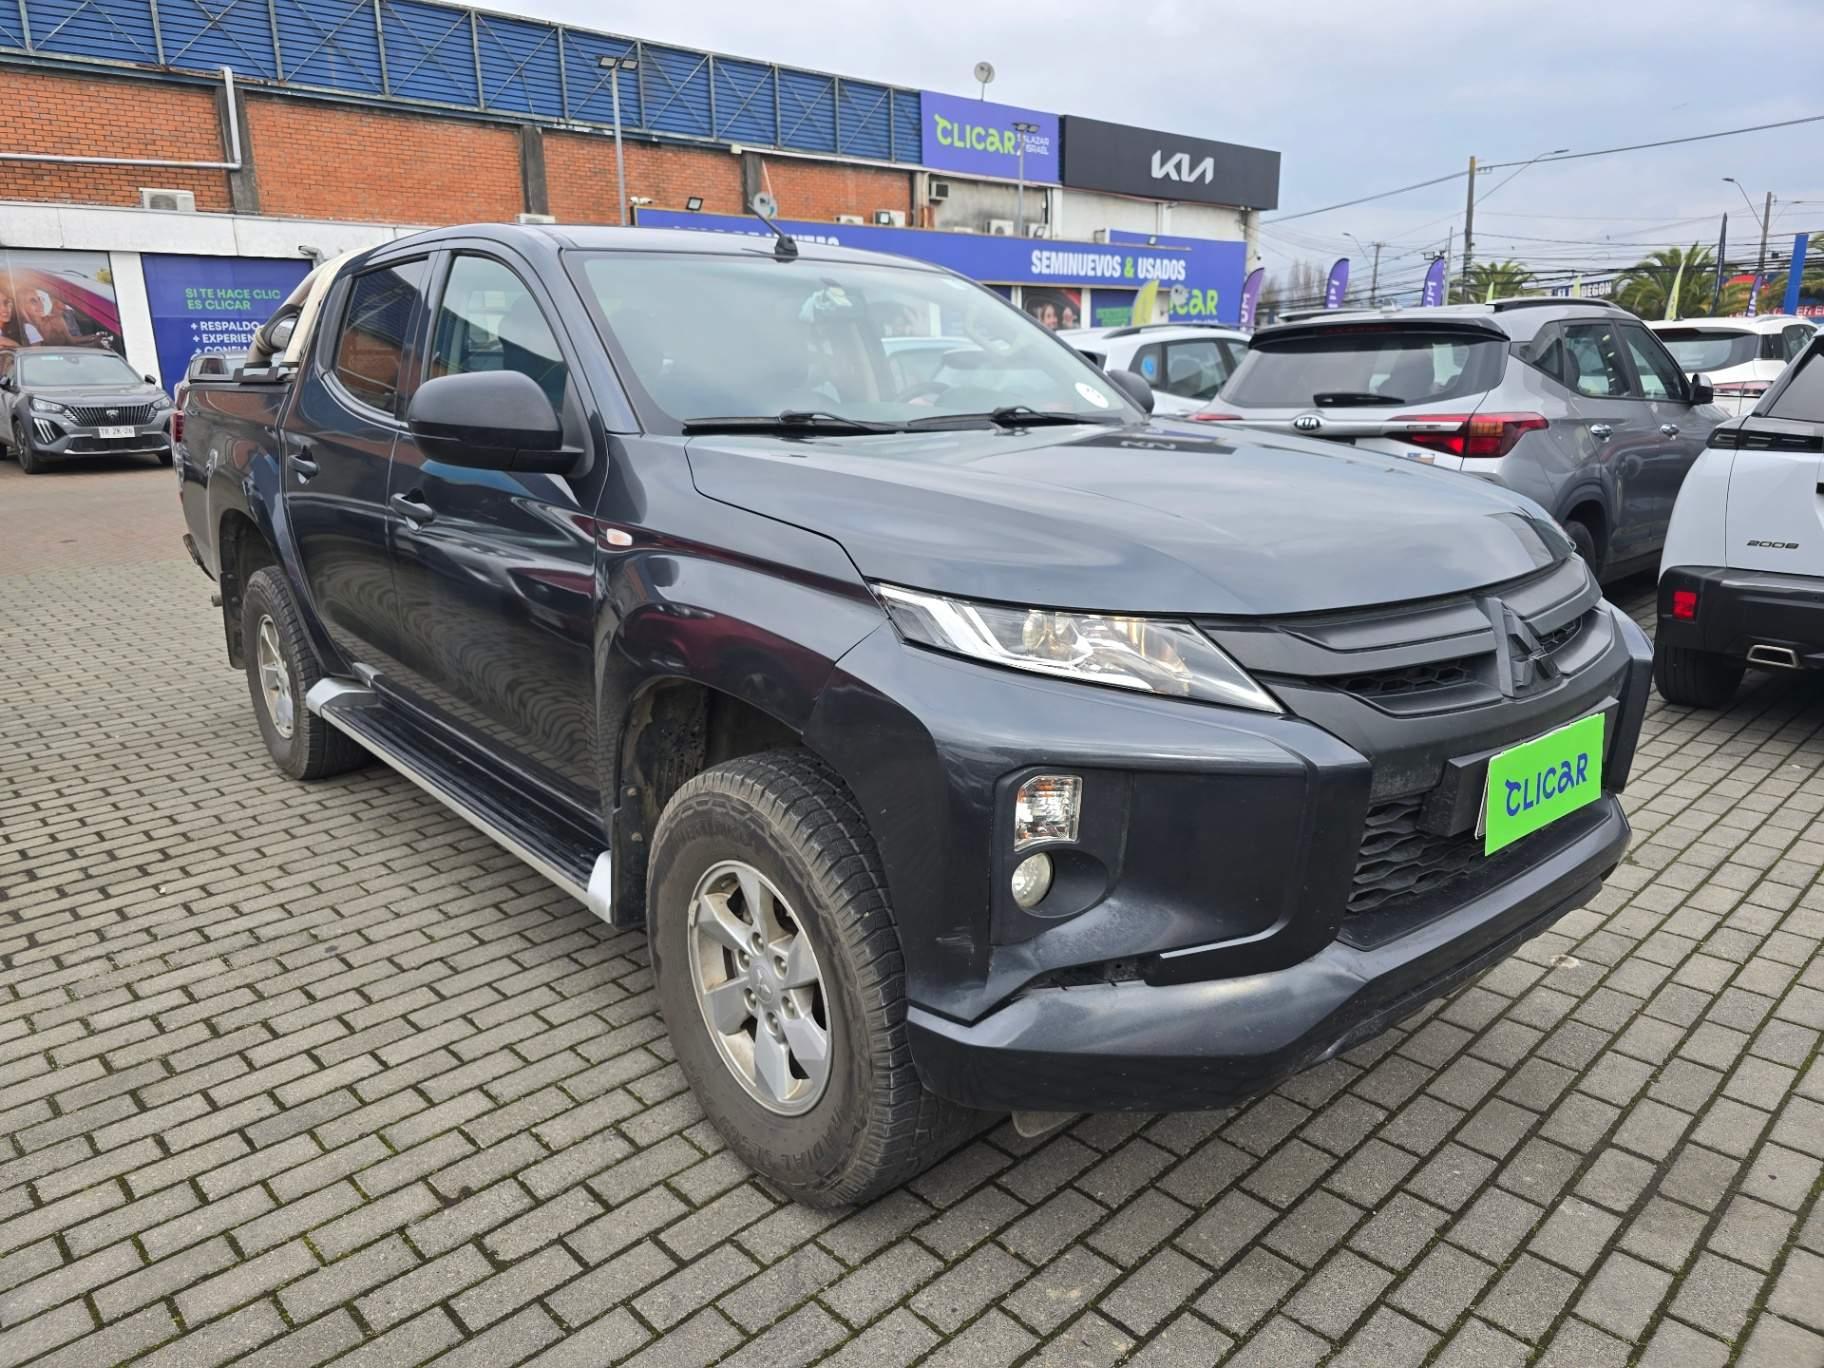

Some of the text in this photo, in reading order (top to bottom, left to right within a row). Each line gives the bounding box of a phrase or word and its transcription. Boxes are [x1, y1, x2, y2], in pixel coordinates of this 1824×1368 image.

[934, 113, 1016, 155] CLICAR
[1031, 249, 1187, 281] SEMINUEVOS & USADOS
[185, 288, 281, 299] SI TE HACE CLIC
[187, 300, 252, 311] ES CLICAR
[200, 321, 260, 331] RESPALDO
[1746, 540, 1800, 550] 2008
[1505, 752, 1589, 817] CLICAR
